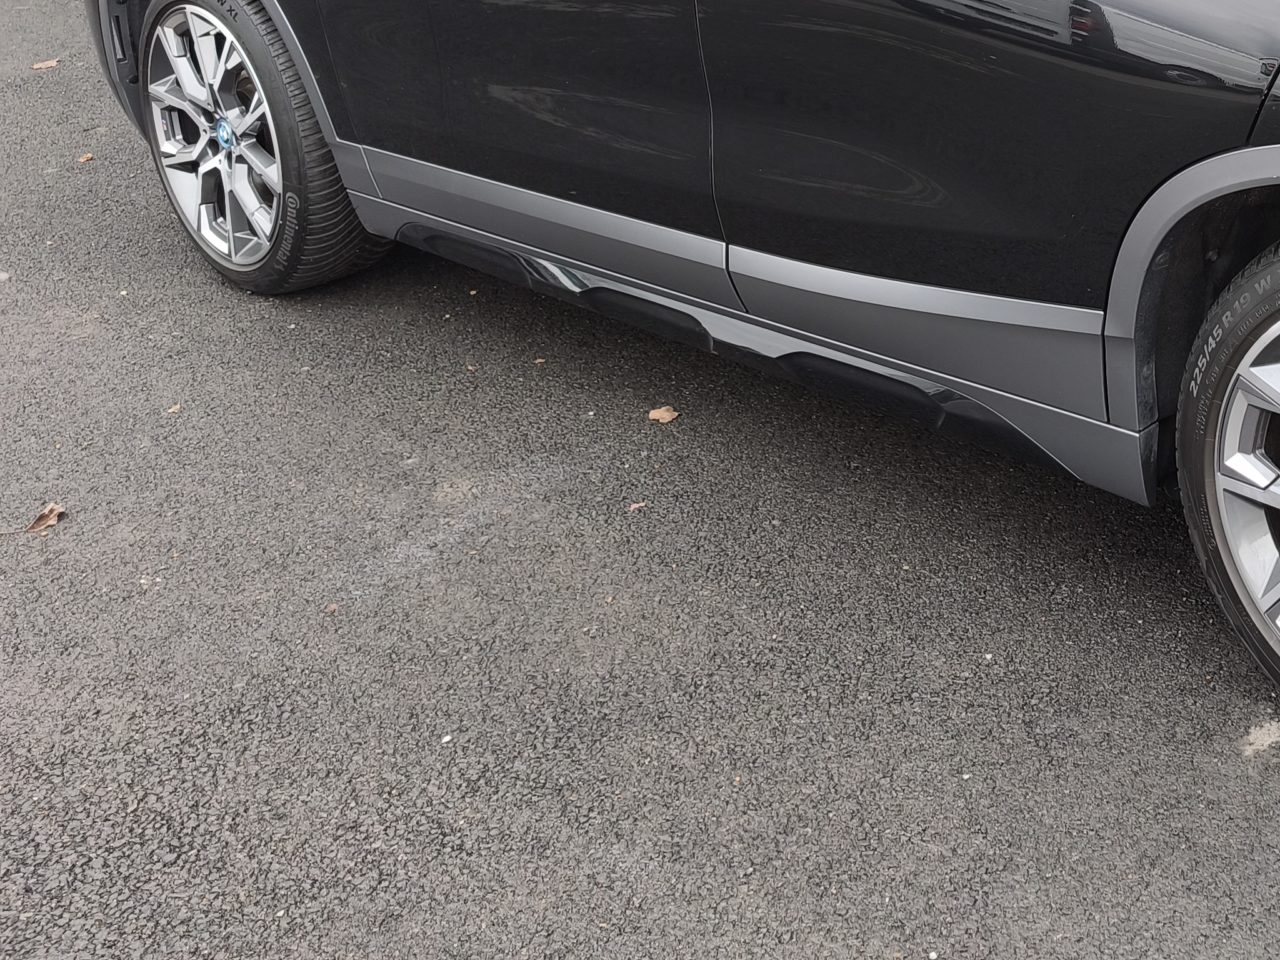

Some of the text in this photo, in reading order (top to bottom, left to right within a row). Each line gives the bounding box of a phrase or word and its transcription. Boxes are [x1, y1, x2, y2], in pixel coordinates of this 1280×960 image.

[226, 4, 239, 23] XL
[276, 192, 299, 265] Continental
[1189, 324, 1224, 398] 225/45
[1221, 310, 1234, 329] R
[1232, 292, 1250, 314] 19
[1254, 274, 1271, 295] W
